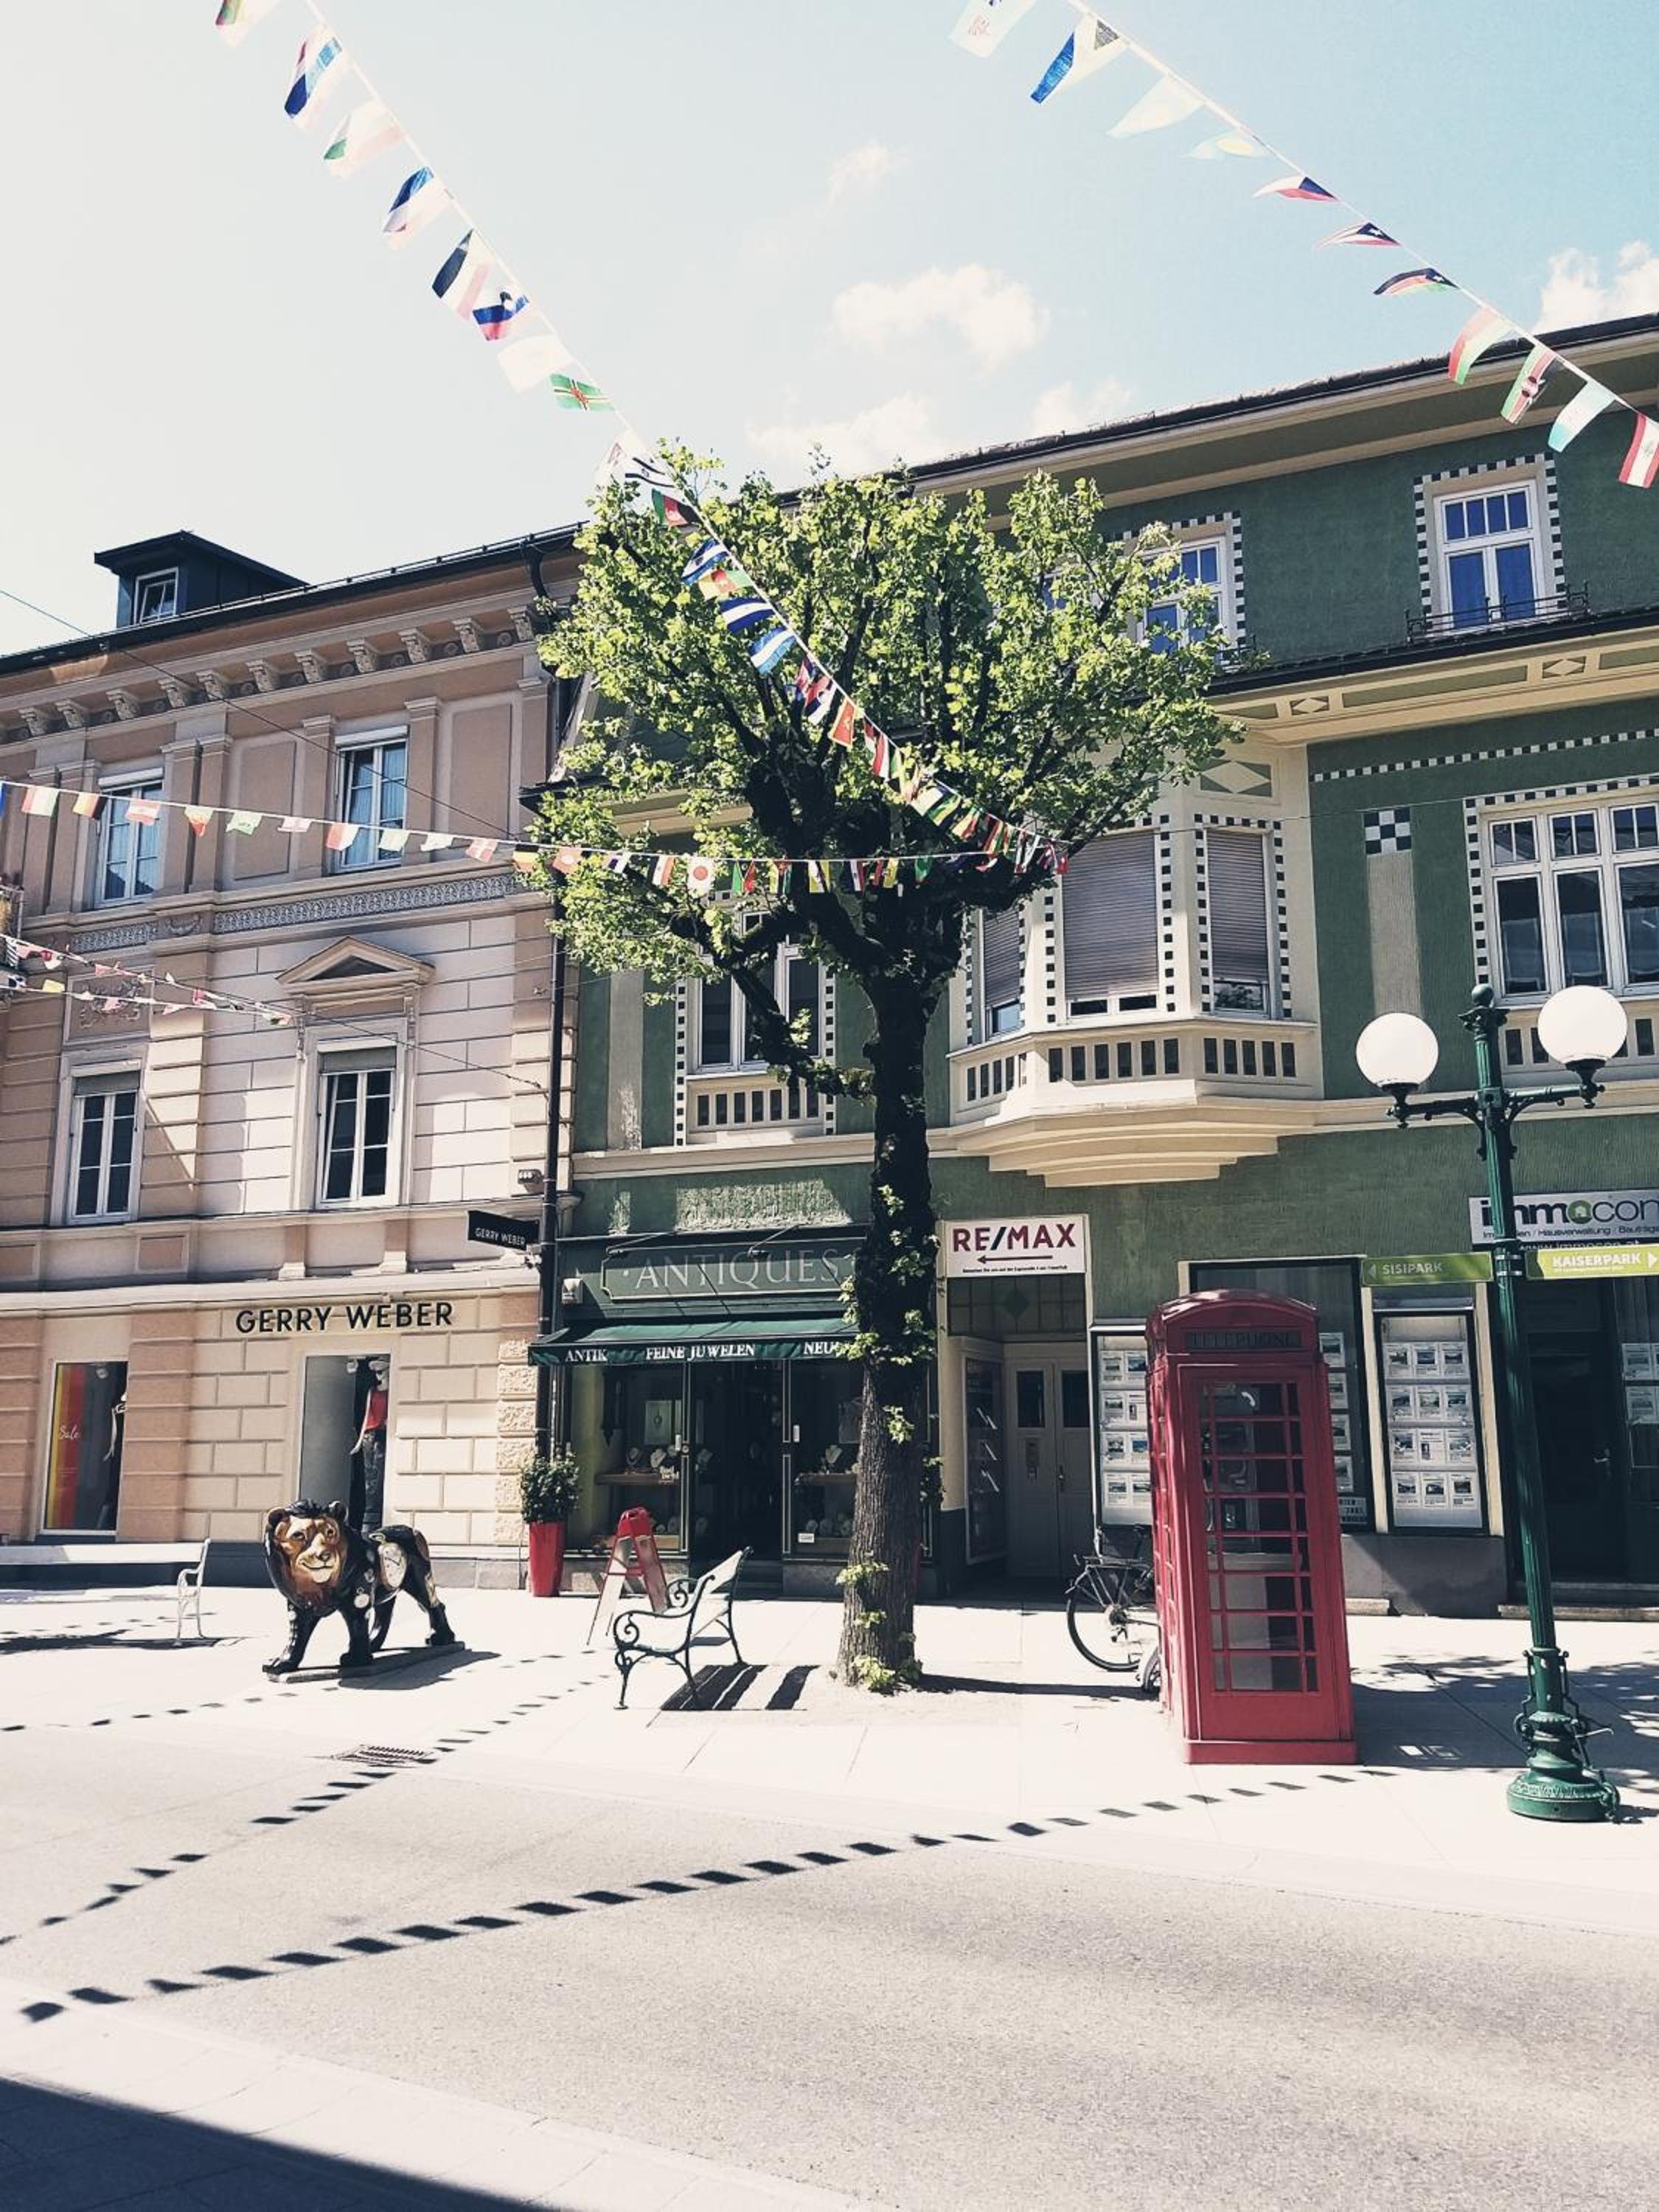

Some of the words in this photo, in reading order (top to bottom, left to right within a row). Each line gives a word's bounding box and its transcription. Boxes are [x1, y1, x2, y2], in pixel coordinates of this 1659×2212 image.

[475, 1227, 499, 1241] GERRY
[501, 1234, 526, 1245] WEBER
[953, 1223, 1076, 1252] RE/MAX
[635, 1248, 839, 1289] ANTIQUES
[1382, 1262, 1443, 1276] SISIPARK
[1552, 1253, 1642, 1268] KAISERPARK
[235, 1307, 332, 1333] GERRY
[346, 1301, 453, 1329] WEBER
[1192, 1332, 1301, 1346] TELEPHONE
[565, 1349, 608, 1362] ANTIK
[646, 1346, 686, 1360] FEINE
[687, 1343, 756, 1362] JUWELEN
[803, 1340, 839, 1355] NEU
